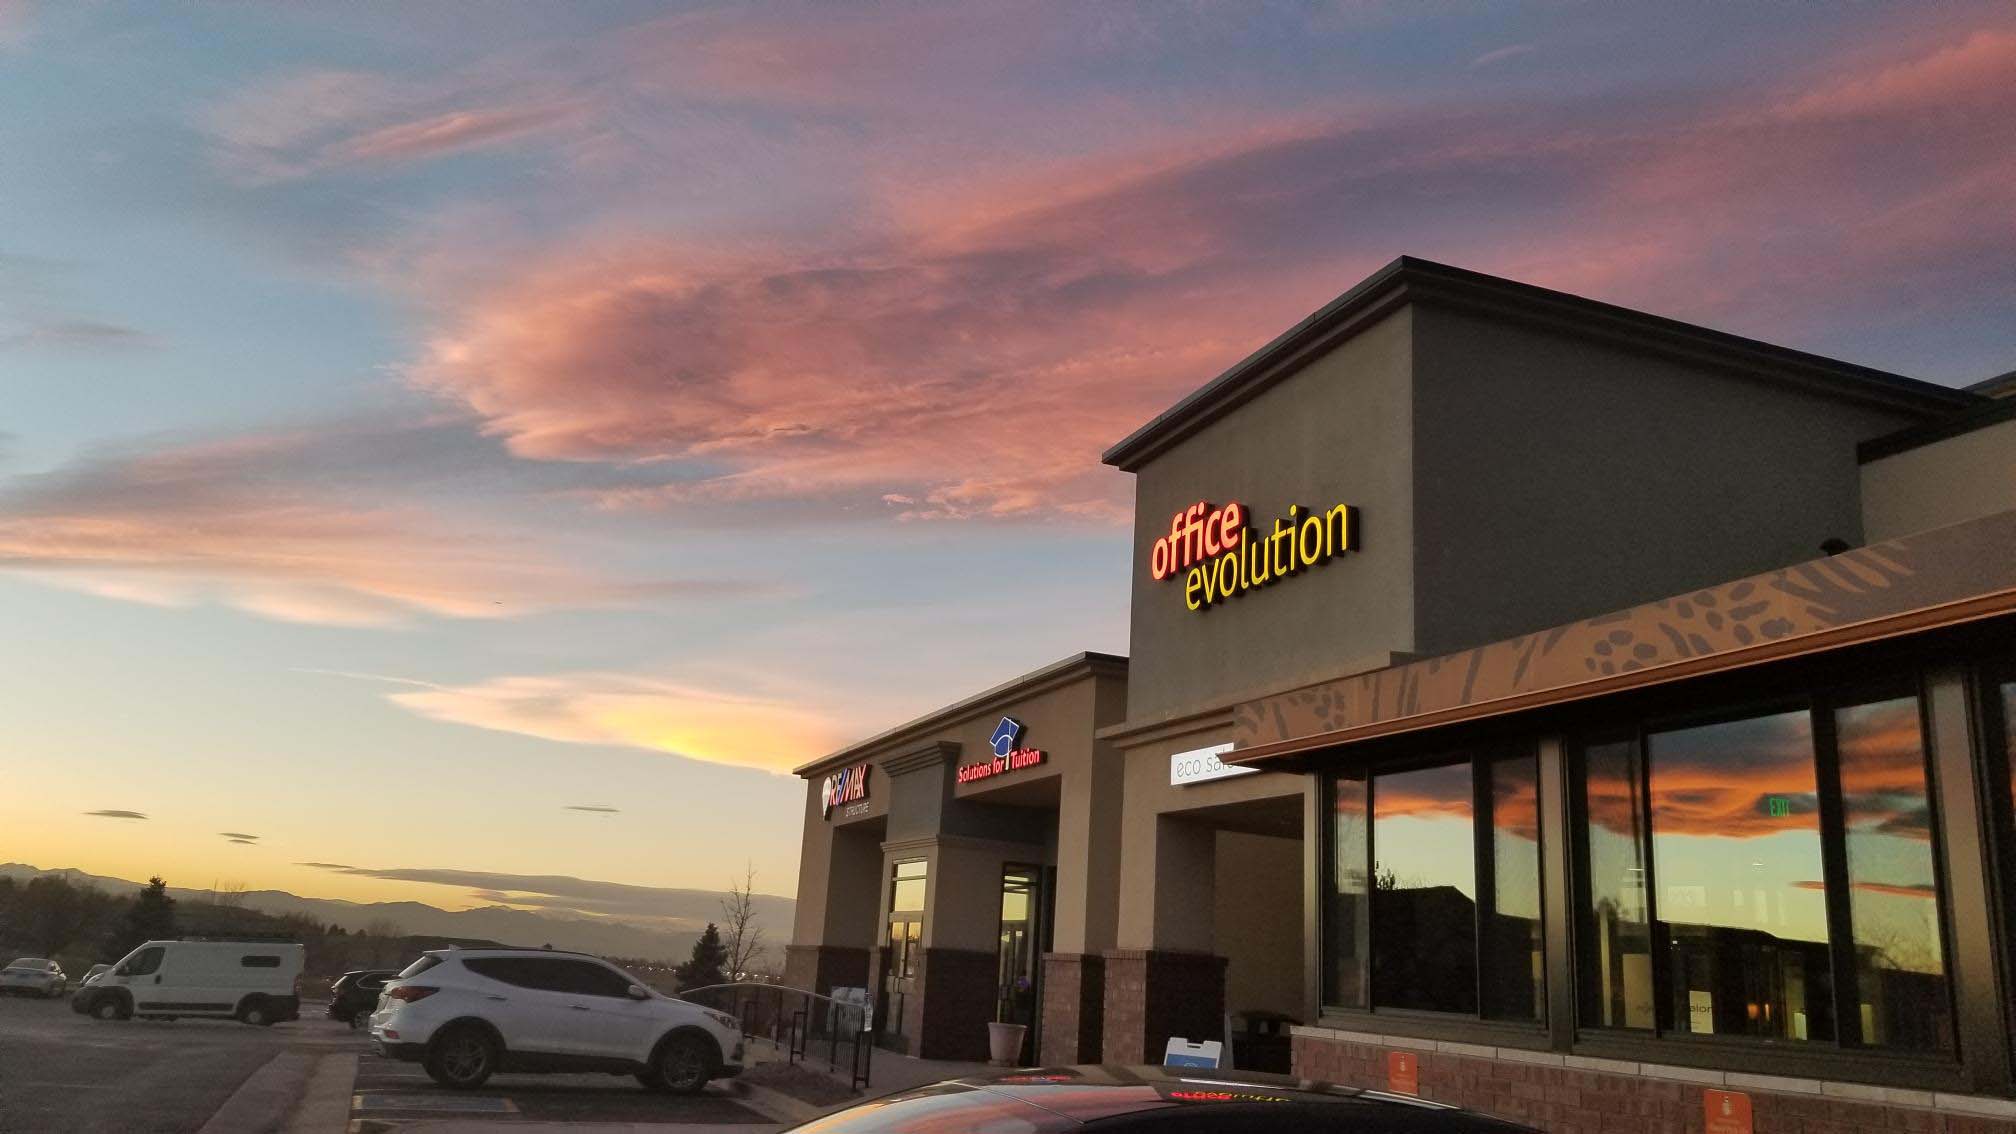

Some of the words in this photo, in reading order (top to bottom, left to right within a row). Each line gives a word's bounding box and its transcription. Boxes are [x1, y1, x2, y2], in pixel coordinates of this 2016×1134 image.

[1151, 500, 1241, 580] office
[1185, 503, 1350, 611] evolution
[958, 763, 991, 783] Solutions
[993, 757, 1005, 775] for
[1011, 748, 1041, 769] Tuition
[1176, 759, 1201, 778] eco
[1769, 797, 1790, 817] EXIT
